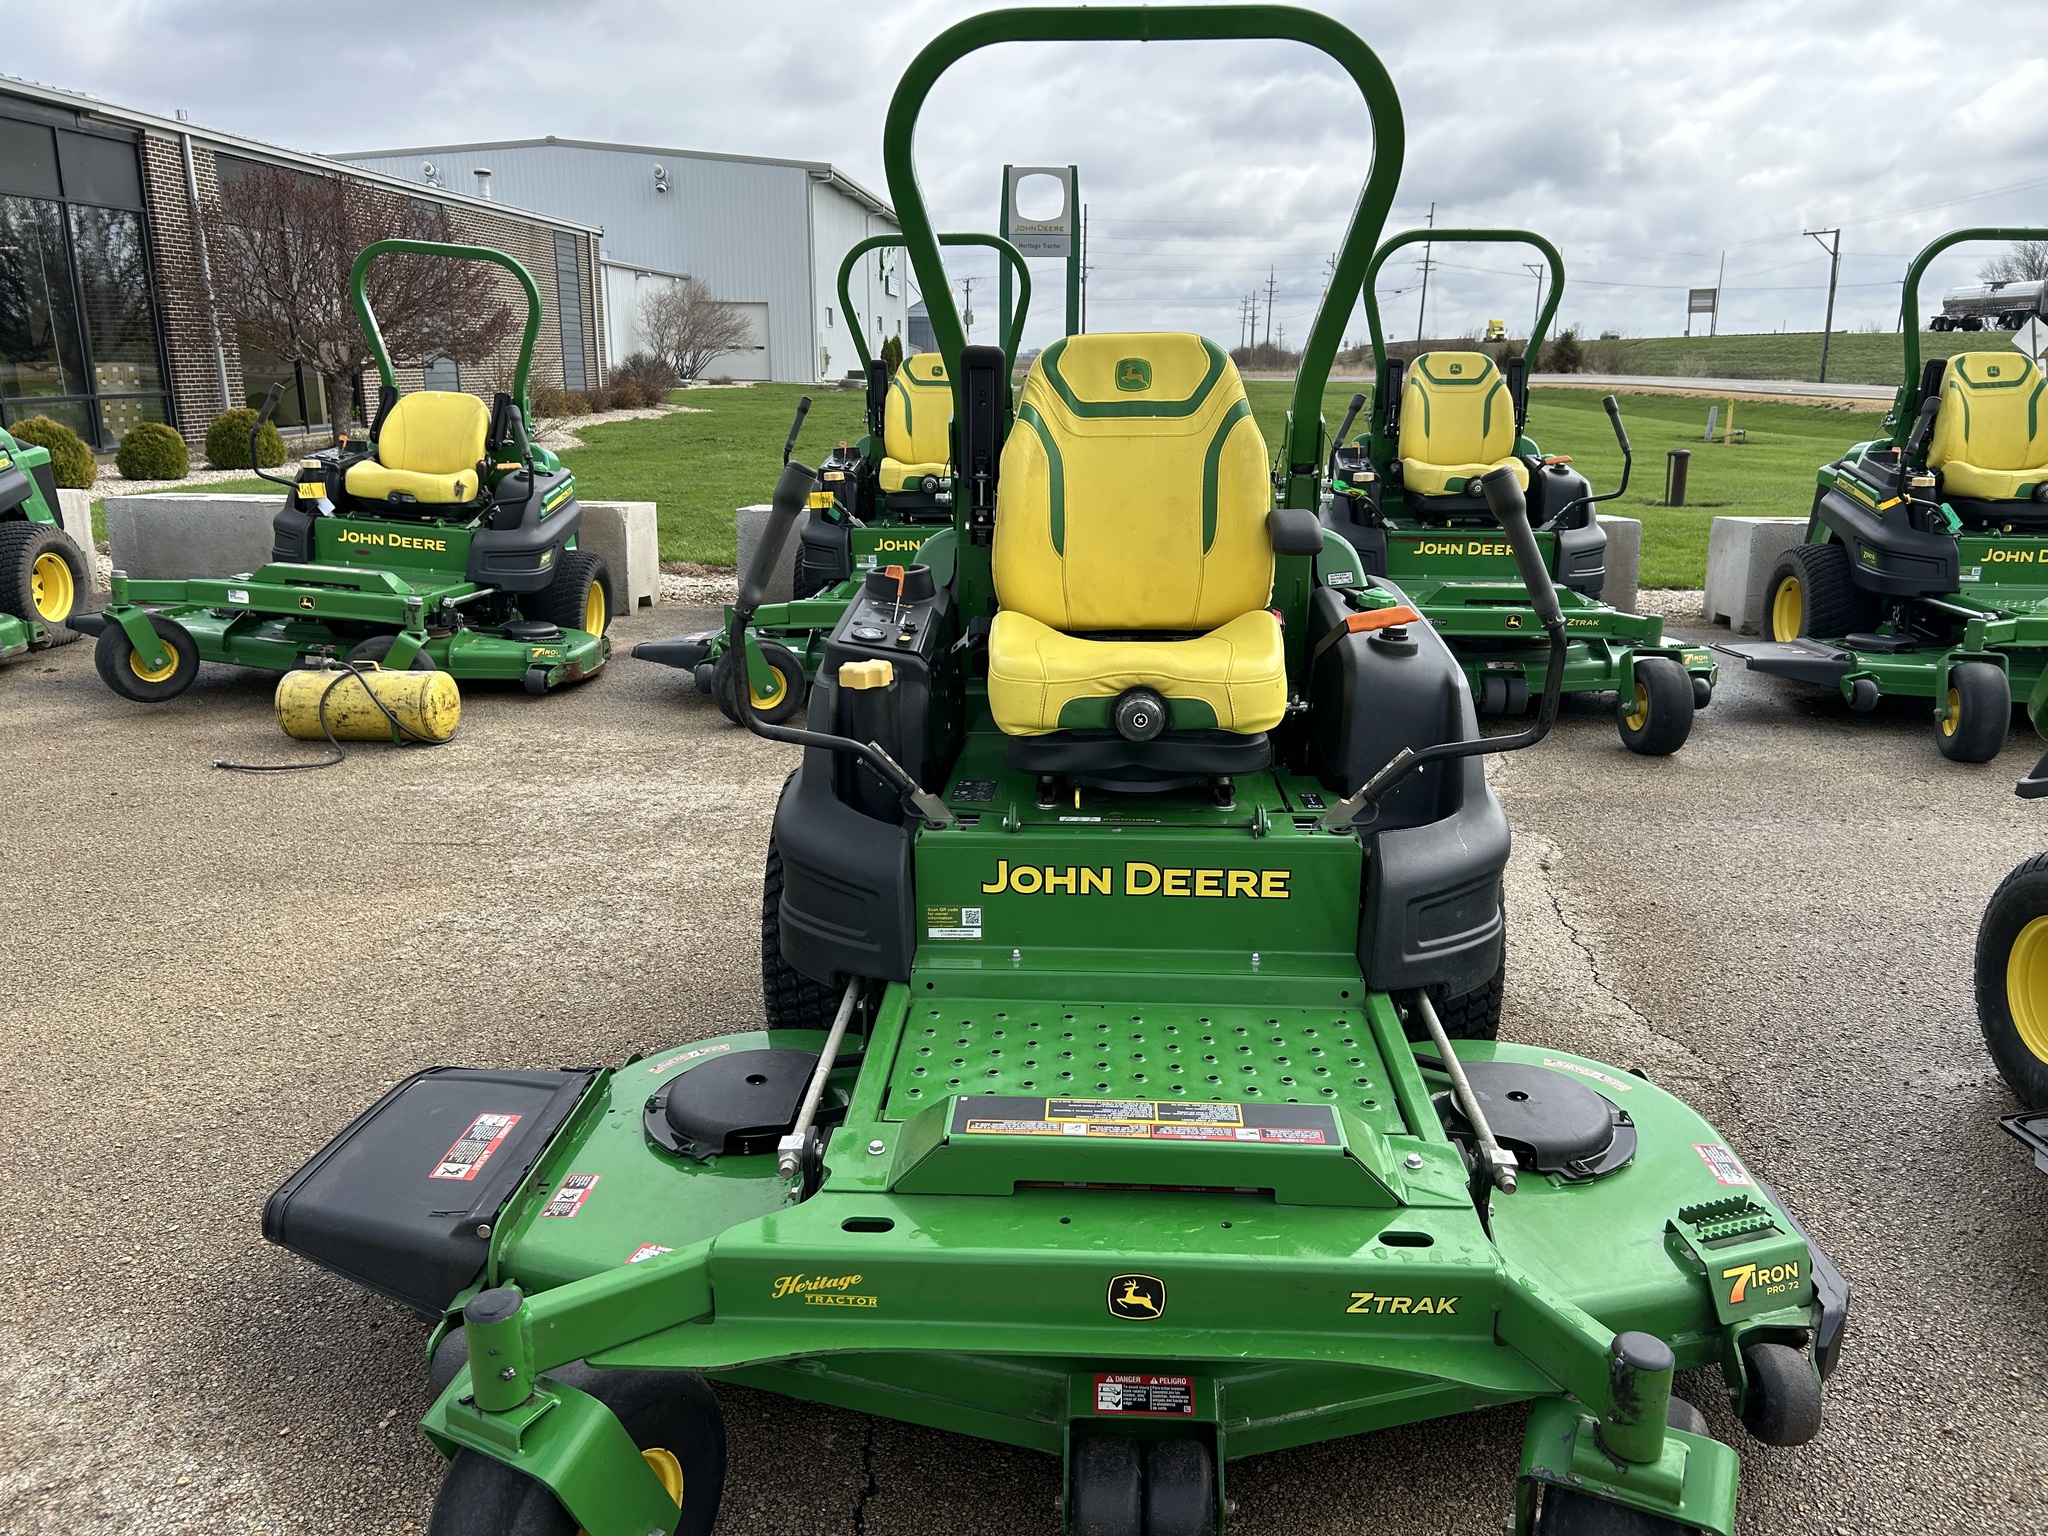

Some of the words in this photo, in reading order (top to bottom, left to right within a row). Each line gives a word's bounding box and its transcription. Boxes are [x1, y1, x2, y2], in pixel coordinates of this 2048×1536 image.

[1014, 224, 1037, 232] JOHN
[1037, 224, 1065, 232] DEERE
[1018, 242, 1042, 250] Heritage
[337, 529, 385, 546] JOHN
[388, 533, 447, 552] DEERE
[873, 537, 921, 552] JOHN
[1413, 541, 1464, 555] JOHN
[1980, 548, 2035, 563] JOHN
[1566, 618, 1600, 626] ZTRAK
[981, 859, 1113, 896] JOHN
[1124, 860, 1292, 899] DEERE
[771, 1273, 863, 1299] Heritage
[1766, 1284, 1785, 1295] PRO
[1788, 1280, 1799, 1291] 72
[805, 1294, 878, 1306] TRACTOR
[1345, 1291, 1462, 1315] ZTRAK
[1115, 1375, 1141, 1383] DANGER
[1159, 1377, 1187, 1385] PELIGRO
